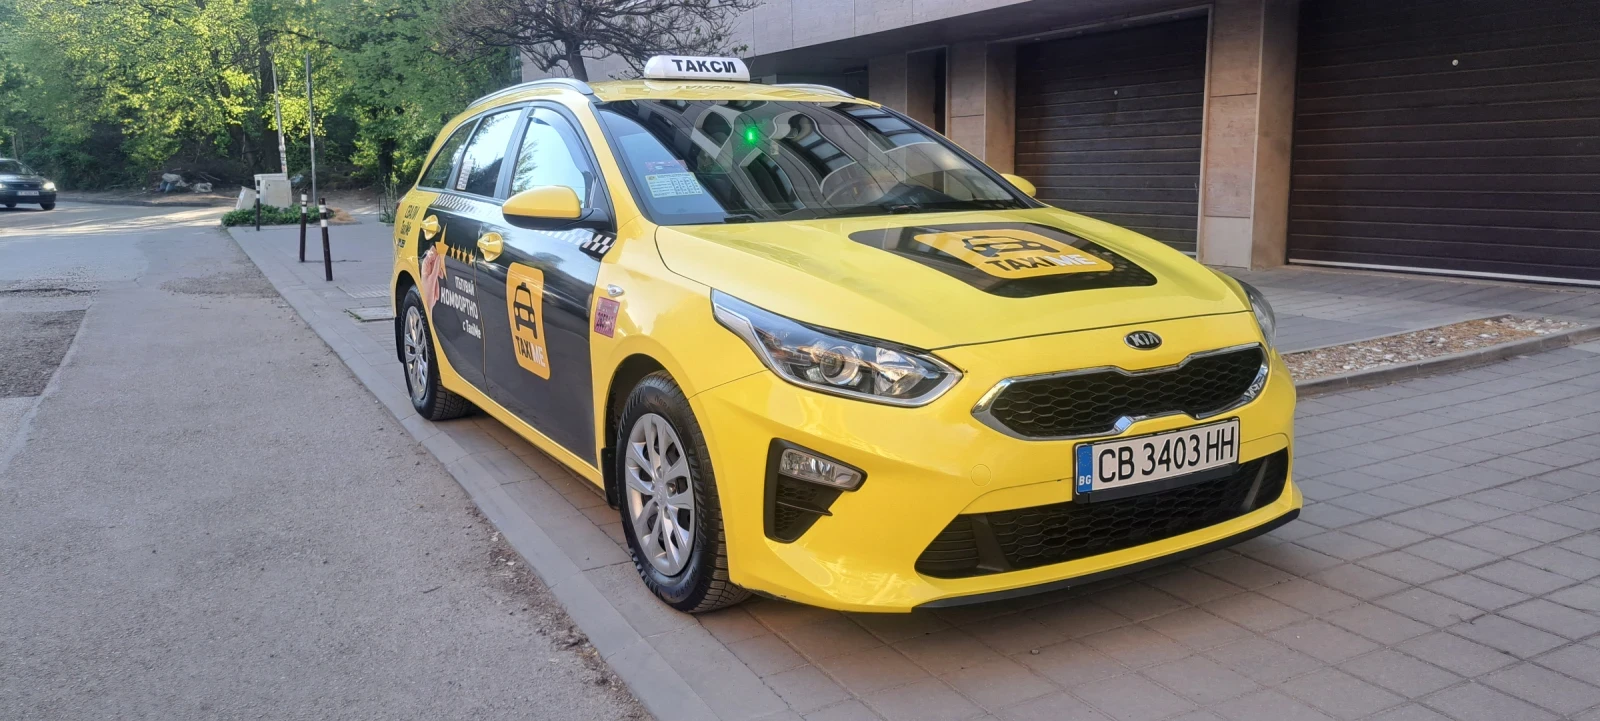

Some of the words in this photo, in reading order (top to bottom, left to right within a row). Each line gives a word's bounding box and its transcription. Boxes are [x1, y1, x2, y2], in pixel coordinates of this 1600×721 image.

[671, 59, 737, 73] ТАКСИ
[440, 286, 479, 320] КОМФОРТНО
[1129, 332, 1160, 347] KIA
[1098, 446, 1135, 483] CB
[1141, 434, 1201, 476] 3403
[1205, 426, 1235, 464] HH
[1079, 475, 1092, 486] BG
